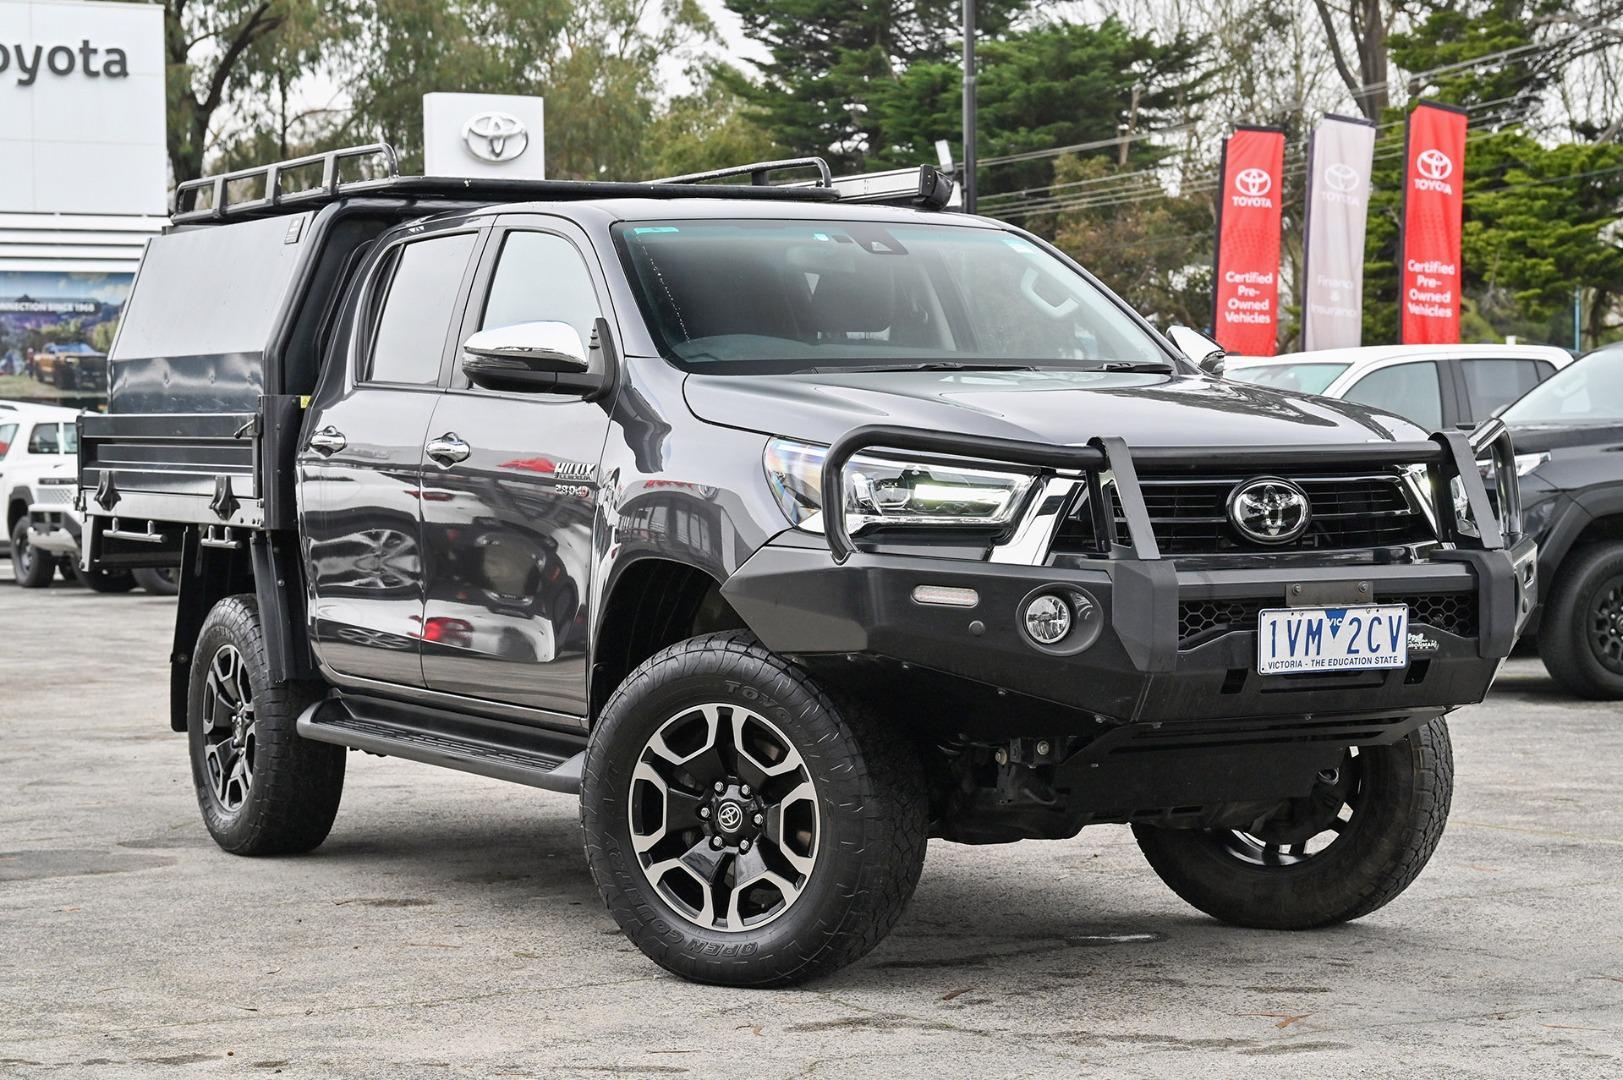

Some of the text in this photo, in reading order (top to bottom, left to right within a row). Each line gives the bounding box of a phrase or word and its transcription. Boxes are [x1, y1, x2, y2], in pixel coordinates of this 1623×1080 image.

[1232, 196, 1272, 208] TOYOTA
[1407, 259, 1455, 274] Certified
[1225, 271, 1273, 284] Certified
[1417, 275, 1442, 288] Pre-
[1238, 285, 1260, 296] Pre-
[1409, 288, 1451, 302] Owned
[1227, 298, 1269, 310] Owned
[1407, 302, 1452, 317] Vehicles
[1225, 312, 1270, 324] Vehicles
[1326, 617, 1343, 627] VIC
[1269, 615, 1402, 658] 1VM 2CV
[1267, 660, 1303, 670] VICTORIA
[1311, 658, 1325, 667] THE
[1328, 657, 1372, 667] EDUCATION
[1375, 655, 1398, 665] STATE
[684, 939, 758, 958] OPEN
